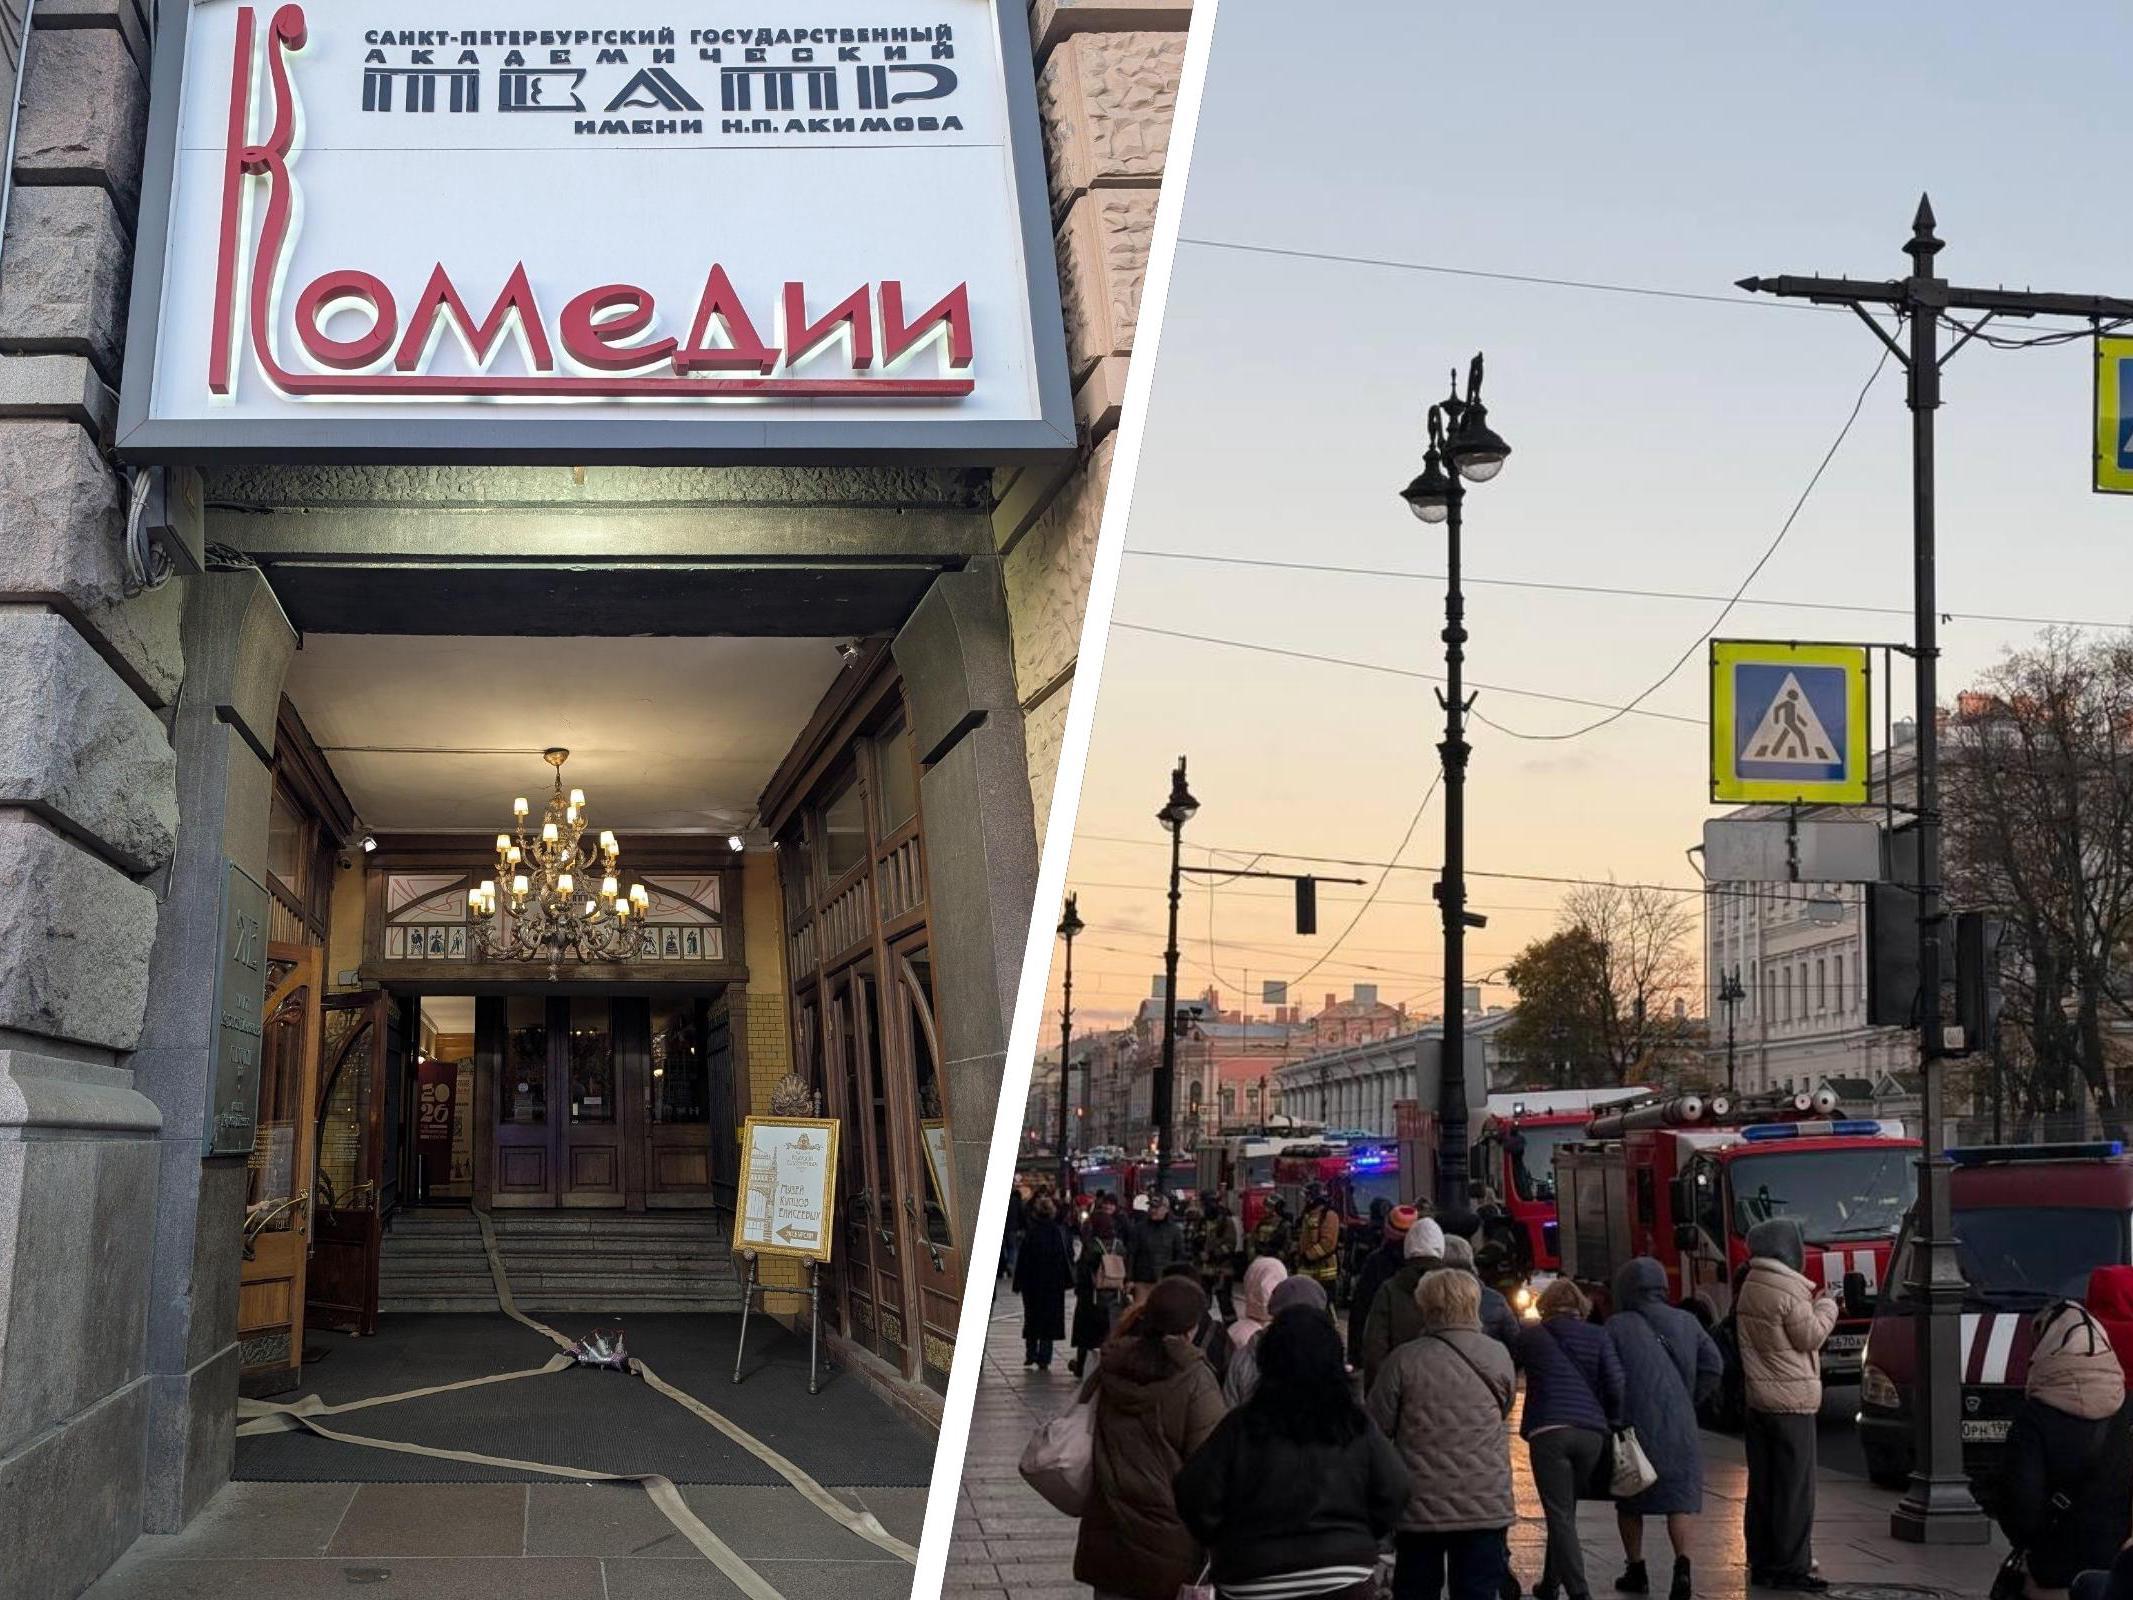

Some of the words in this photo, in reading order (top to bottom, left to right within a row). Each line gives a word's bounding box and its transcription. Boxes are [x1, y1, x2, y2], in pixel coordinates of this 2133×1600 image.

[364, 26, 675, 46] САНКТ-ПЕТЕРБУРГСКИЙ
[690, 23, 955, 46] ГОСУДАРСТВЕННЫЙ
[364, 43, 956, 67] АКАДЕМИЧЕСКИЙ
[361, 64, 958, 113] ТЕАТР
[574, 119, 703, 135] ИМЕНИ
[420, 1104, 449, 1122] 26
[779, 1196, 809, 1208] КУПЦОВ
[778, 1208, 821, 1221] ЕЛИСЕЕВЫХ
